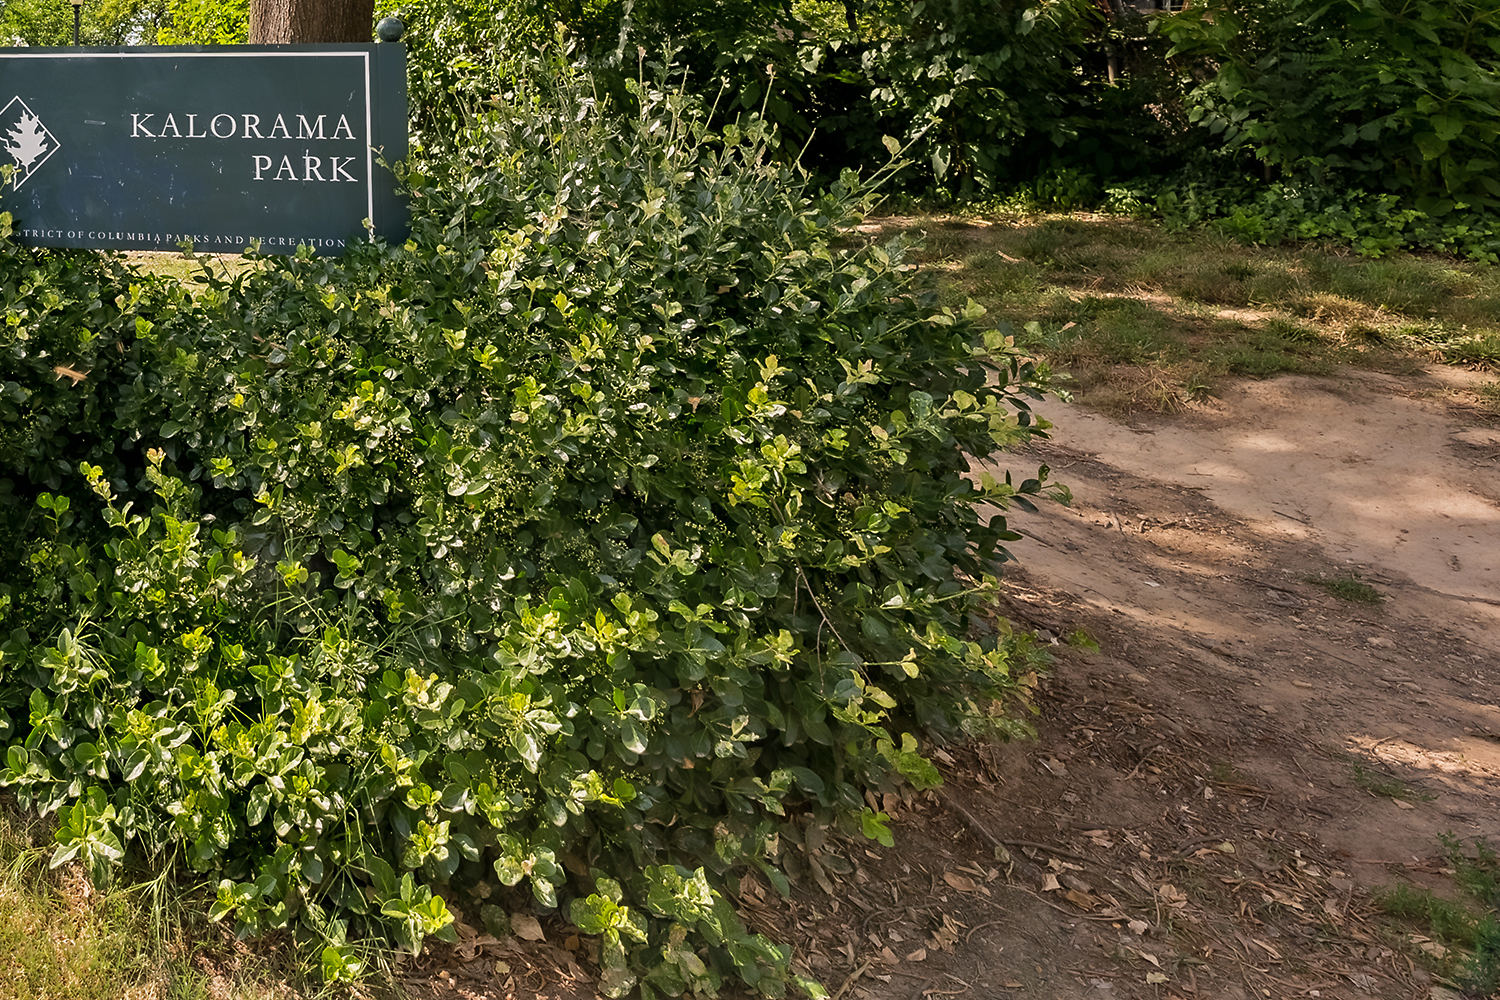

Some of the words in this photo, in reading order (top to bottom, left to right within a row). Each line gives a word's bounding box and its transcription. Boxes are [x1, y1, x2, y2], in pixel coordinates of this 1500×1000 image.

[130, 113, 356, 140] KALORAMA
[252, 154, 358, 182] PARK
[13, 229, 63, 238] TRICT
[67, 230, 84, 239] OF
[88, 231, 161, 242] COLUMBIA
[166, 233, 210, 244] PARKS
[214, 235, 244, 245] AND
[249, 236, 346, 248] RECREATION
